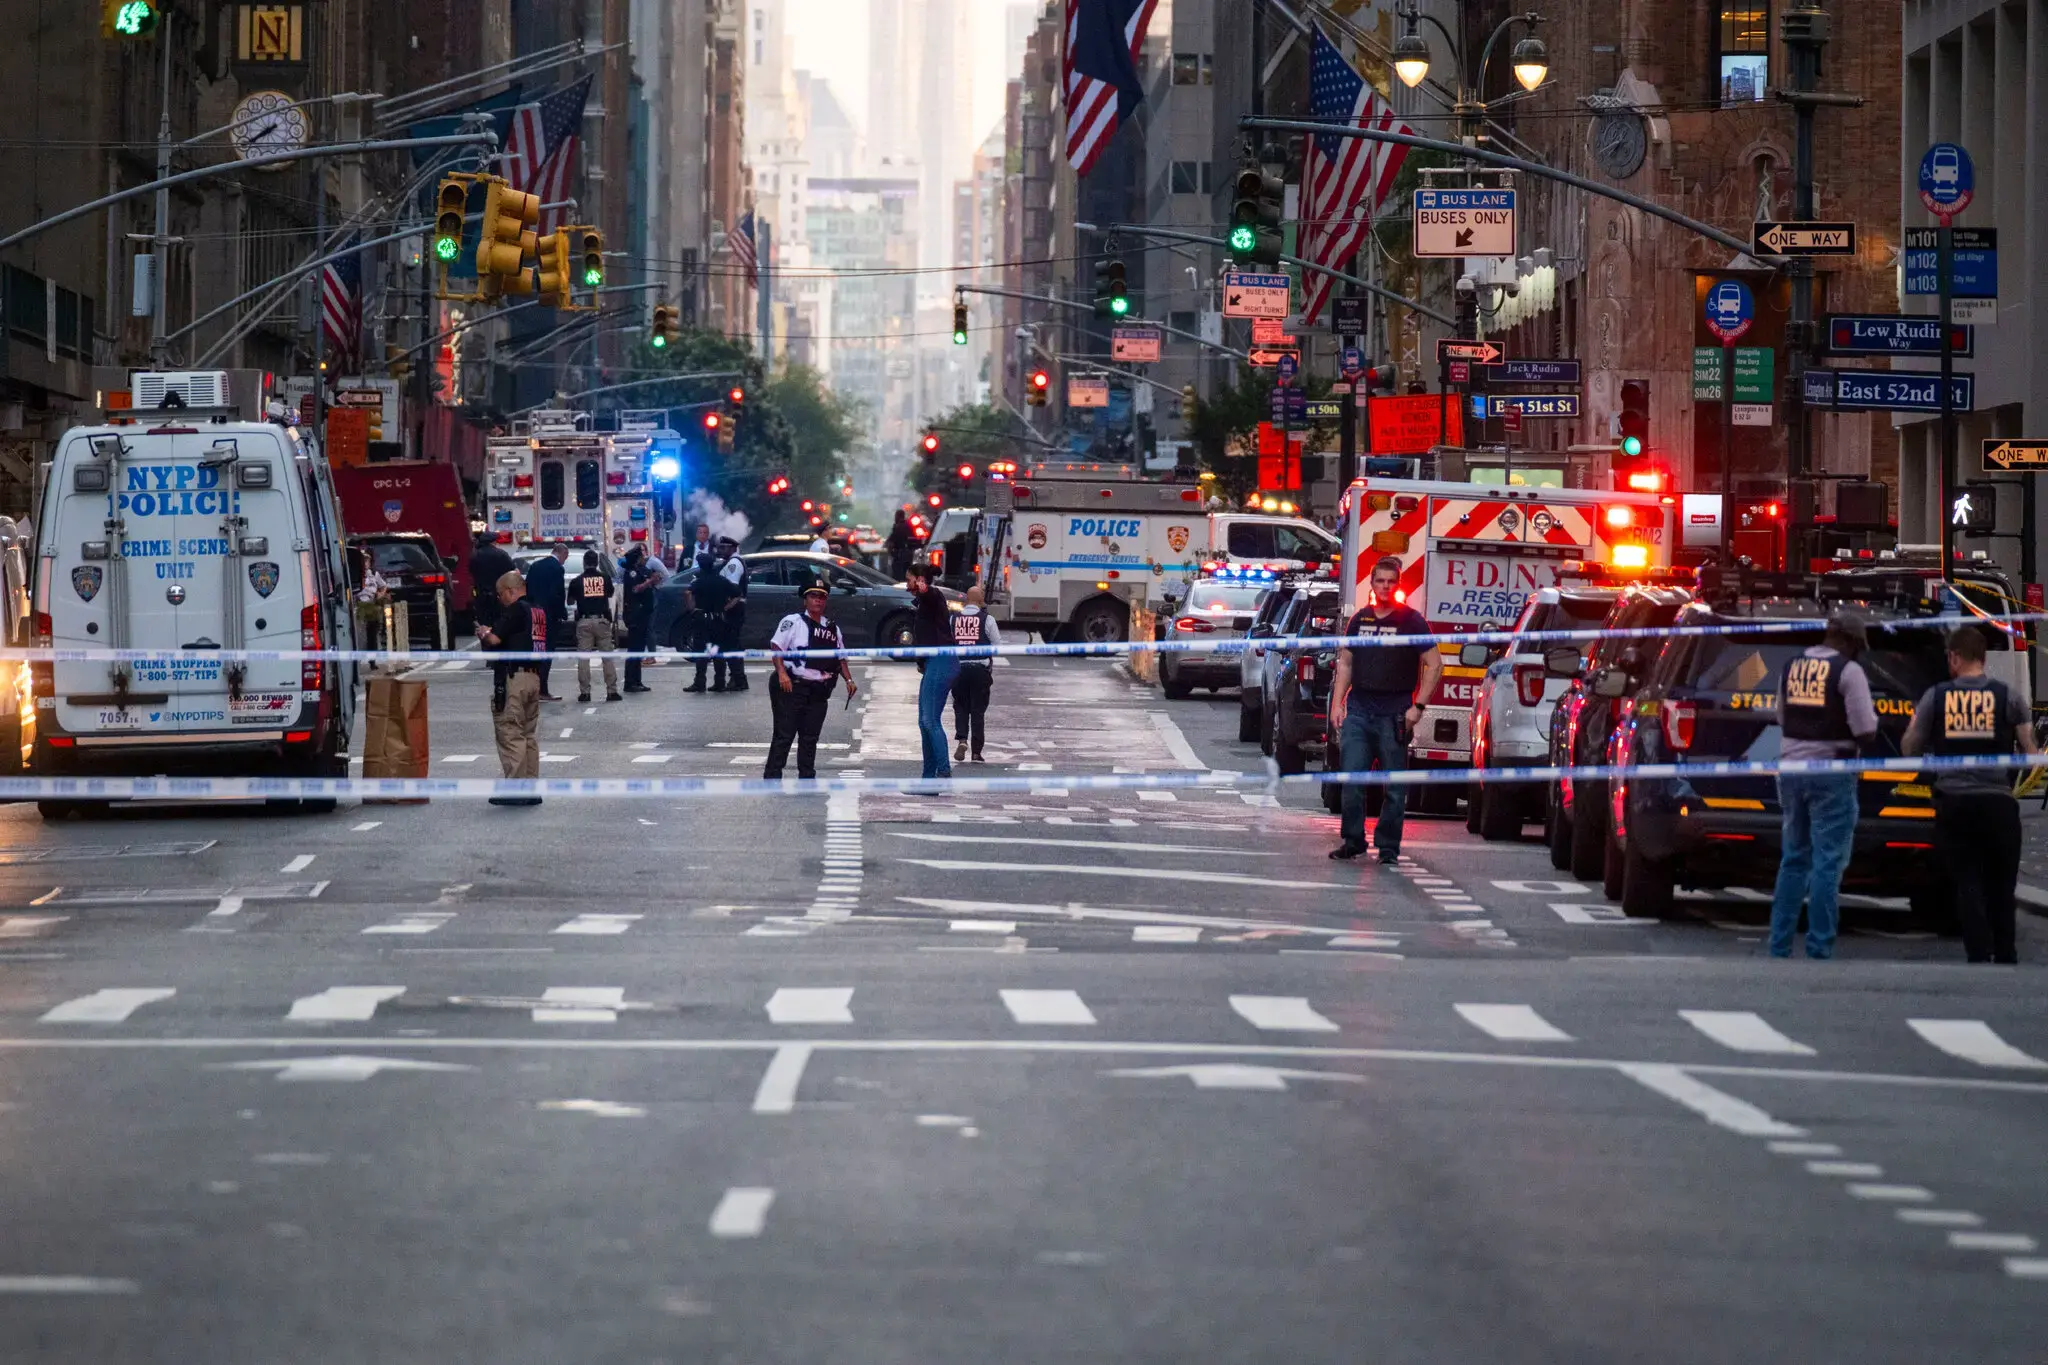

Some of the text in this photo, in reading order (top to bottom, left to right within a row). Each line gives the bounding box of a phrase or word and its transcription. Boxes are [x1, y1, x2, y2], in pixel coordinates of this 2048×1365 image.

[258, 14, 283, 53] N
[1441, 195, 1508, 205] BUS LANE
[1934, 194, 1968, 213] STANDING
[1420, 211, 1509, 224] BUSES ONLY
[1769, 232, 1842, 245] ONE WAY
[1907, 231, 1938, 248] M101
[1907, 252, 1937, 269] M102
[1966, 253, 1985, 264] Village
[1242, 276, 1286, 286] BUS LANE
[1907, 275, 1937, 292] M103
[1244, 305, 1284, 314] RIGHT TURNS
[1854, 321, 1890, 337] Lew
[1888, 338, 1911, 349] Way
[1471, 347, 1491, 357] WAY
[1507, 363, 1560, 373] Jack Rudin
[1695, 367, 1720, 381] SIM22
[1525, 372, 1542, 380] Way
[1695, 385, 1721, 399] SIM26
[1837, 380, 1881, 399] East
[1887, 383, 1935, 402] 52nd
[1318, 404, 1340, 415] 50th
[1527, 400, 1554, 412] 51st
[1557, 400, 1571, 412] St
[1997, 449, 2024, 461] ONE
[127, 465, 219, 490] NYPD
[108, 491, 240, 517] POLICE
[1069, 518, 1141, 537] POLICE
[121, 538, 229, 557] CRIME SCENE
[1068, 553, 1140, 563] EMERGENCY SERVICE
[155, 562, 195, 579] UNIT
[583, 576, 604, 586] NYPD
[584, 586, 604, 594] POLICE
[955, 616, 980, 628] NYPD
[955, 627, 980, 636] POLICE
[134, 659, 222, 669] CRIME STOPPERS
[1788, 658, 1830, 681] NYPD
[138, 669, 218, 681] 1-800-577-TIPS
[1787, 678, 1826, 698] POLICE
[261, 694, 294, 702] REWARD
[1730, 692, 1778, 709] STAT
[1945, 690, 1995, 713] NYPD
[100, 712, 129, 724] 7057
[163, 711, 225, 722] @NYPDTIPS
[1945, 711, 1995, 731] POLICE
